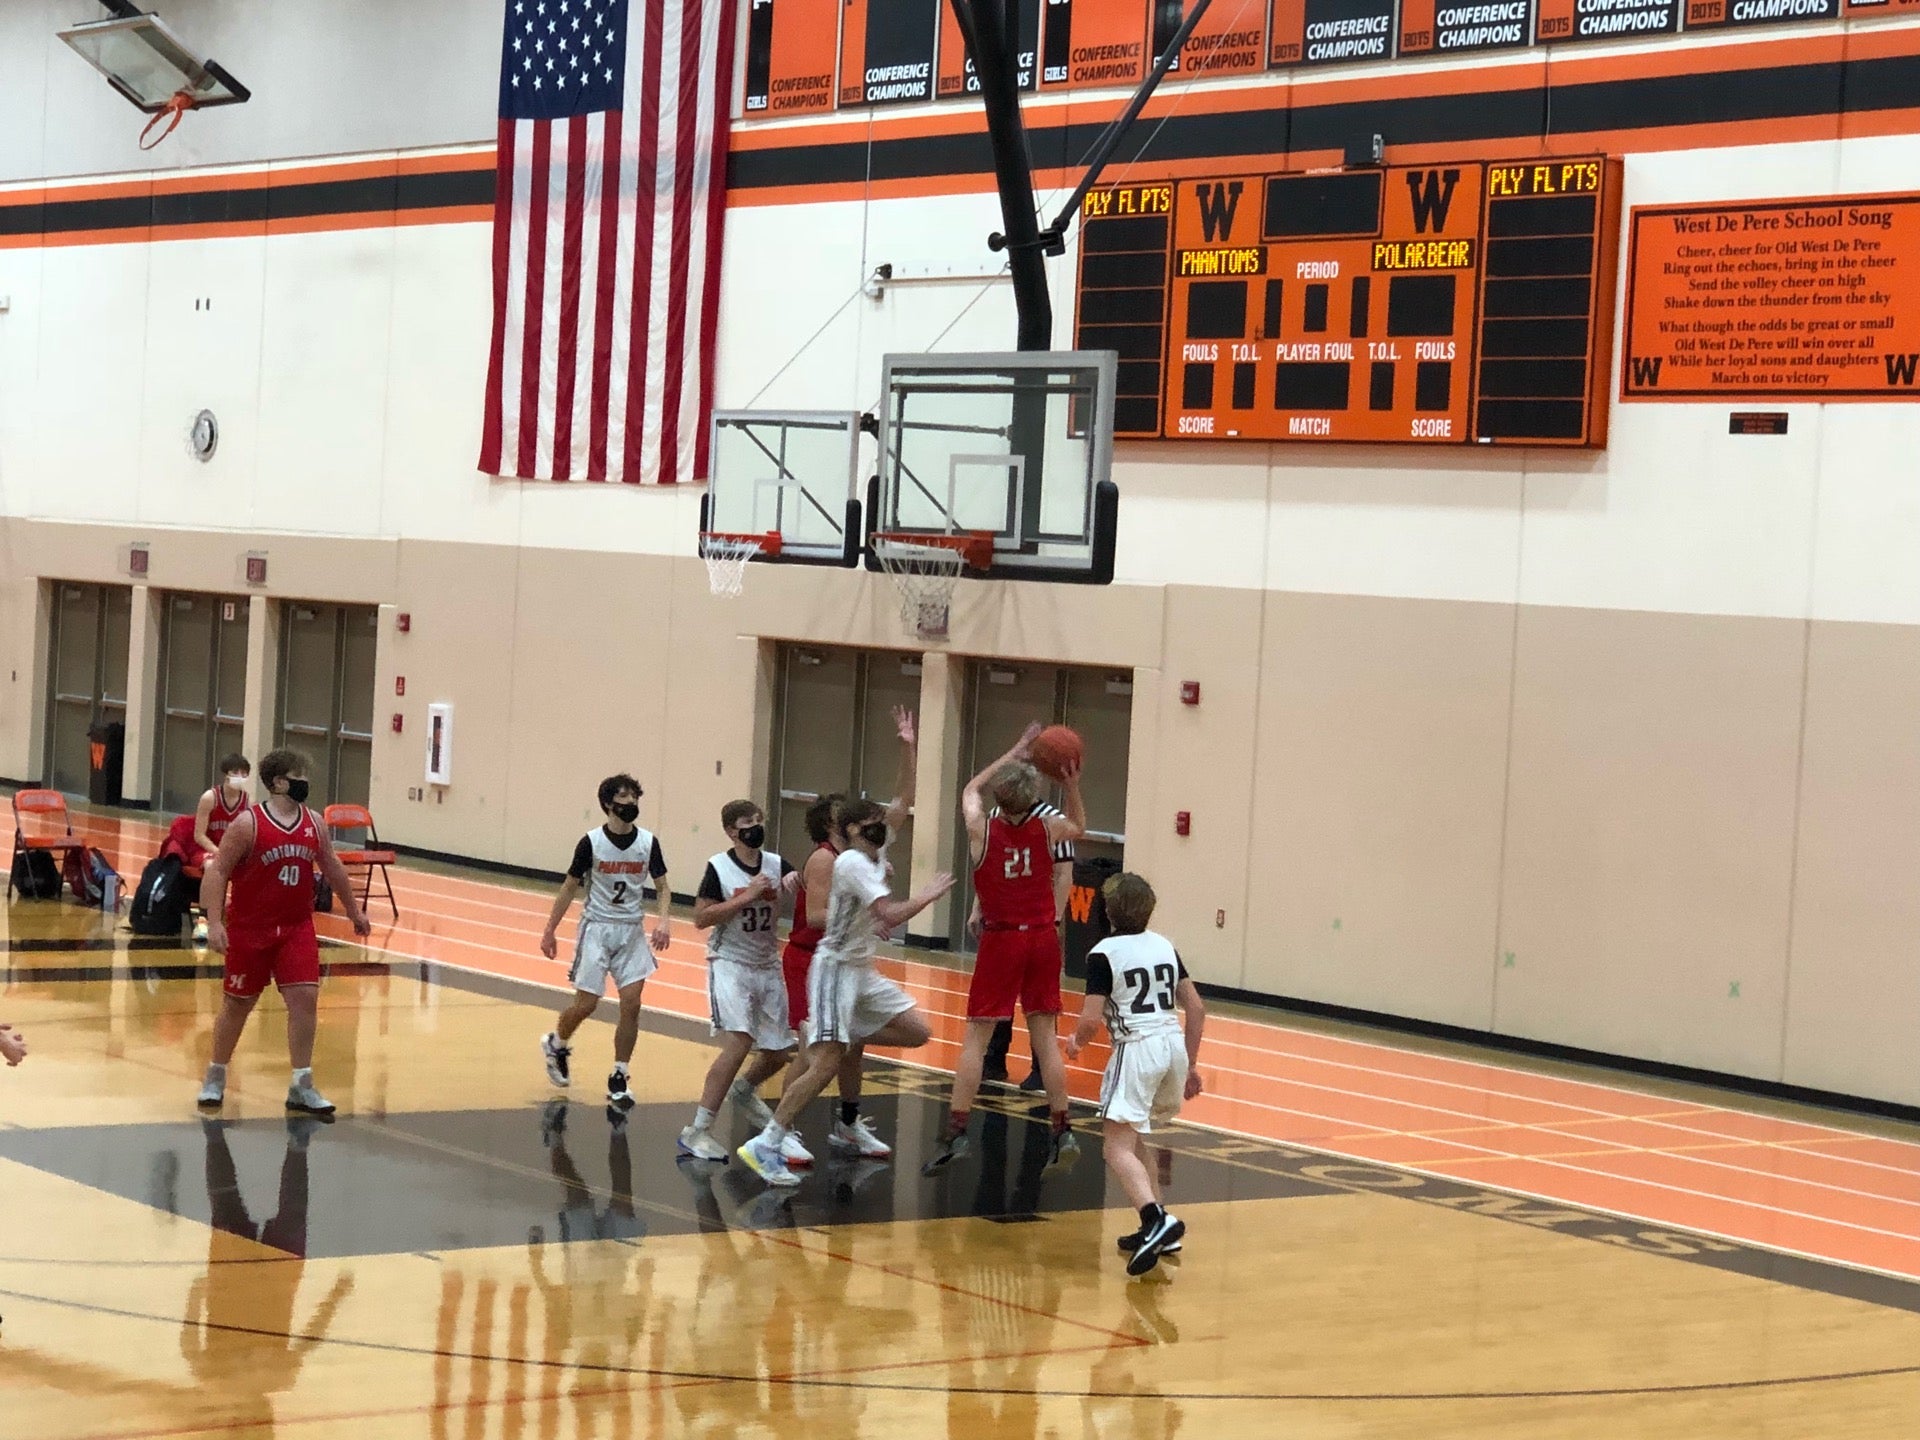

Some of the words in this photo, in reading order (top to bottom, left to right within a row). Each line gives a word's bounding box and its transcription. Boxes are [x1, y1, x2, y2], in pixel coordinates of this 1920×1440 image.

[1437, 2, 1525, 27] CONFERENCE
[1578, 0, 1672, 12] CONFE
[1691, 2, 1721, 20] BOYS
[1733, 0, 1828, 20] CHAMPIONS
[1307, 16, 1389, 39] CONFERENCE
[1542, 17, 1569, 34] BOYS
[1580, 10, 1669, 34] CHAMPIONS
[1184, 31, 1260, 52] CONFERENCE
[1439, 24, 1522, 48] CHAMPIONS
[1072, 42, 1141, 63] CONFERENCE
[1308, 37, 1384, 60] CHAMPIONS
[1074, 62, 1138, 82] CHAMPIONS
[1186, 52, 1256, 72] CHAMPIONS
[772, 74, 831, 92] CONFERENCE
[866, 63, 930, 83] CONFERENCE
[1044, 66, 1067, 82] GIRLS
[773, 92, 828, 110] CHAMPIONS
[867, 82, 926, 100] CHAMPIONS
[1490, 168, 1524, 195] PLY
[1533, 166, 1555, 193] FL
[1561, 164, 1598, 191] PTS
[1084, 190, 1112, 216] PLY
[1118, 190, 1136, 214] FL
[1140, 188, 1170, 212] PTS
[1406, 169, 1460, 234] W
[1196, 182, 1243, 242] W
[1673, 217, 1710, 234] West
[1716, 215, 1738, 232] De
[1743, 214, 1780, 230] Pere
[1784, 210, 1843, 229] School
[1848, 208, 1893, 230] Song
[1677, 246, 1716, 258] Cheer,
[1719, 244, 1752, 256] cheer
[1755, 243, 1772, 255] for
[1776, 241, 1798, 254] Old
[1802, 240, 1829, 252] West
[1834, 240, 1850, 252] De
[1853, 239, 1881, 251] Pere
[1181, 250, 1259, 275] PHANTOMS
[1296, 261, 1338, 279] PERIOD
[1664, 262, 1691, 277] Ring
[1694, 263, 1713, 273] out
[1716, 260, 1734, 272] the
[1738, 260, 1782, 273] echoes,
[1785, 258, 1818, 272] bring
[1822, 258, 1834, 268] in
[1838, 256, 1858, 268] the
[1861, 255, 1896, 268] cheer
[1688, 278, 1718, 290] Send
[1721, 278, 1740, 290] the
[1743, 277, 1778, 292] volley
[1781, 276, 1815, 288] cheer
[1818, 278, 1834, 286] on
[1838, 274, 1866, 290] high
[1664, 296, 1700, 309] Shake
[1702, 296, 1734, 308] down
[1738, 294, 1757, 306] the
[1760, 294, 1809, 306] thunder
[1812, 292, 1842, 304] from
[1846, 292, 1866, 304] the
[1870, 291, 1891, 307] sky
[1660, 321, 1690, 333] What
[1692, 320, 1734, 335] though
[1737, 320, 1756, 331] the
[1759, 319, 1788, 330] odds
[1790, 318, 1804, 330] be
[1808, 320, 1840, 333] great
[1843, 320, 1856, 329] or
[1860, 316, 1894, 329] small
[1182, 344, 1218, 361] FOULS
[1231, 344, 1262, 361] T.O.L.
[1276, 344, 1320, 360] PLAYER
[1324, 343, 1354, 360] FOUL
[1368, 342, 1401, 360] T.O.L.
[1415, 342, 1456, 360] FOULS
[1675, 338, 1695, 351] Old
[1699, 338, 1726, 350] West
[1729, 338, 1744, 350] De
[1747, 338, 1774, 349] Pere
[1777, 337, 1798, 349] will
[1802, 337, 1824, 348] win
[1828, 340, 1855, 348] over
[1858, 336, 1874, 348] all
[1632, 356, 1662, 386] W
[1668, 355, 1702, 367] While
[1706, 354, 1725, 366] her
[1728, 354, 1757, 369] loyal
[1760, 356, 1786, 366] sons
[1790, 354, 1813, 365] and
[1817, 353, 1879, 368] daughters
[1884, 354, 1920, 385] W
[1712, 372, 1750, 383] March
[1752, 374, 1768, 383] on
[1771, 373, 1783, 383] to
[1786, 371, 1829, 387] victory
[1178, 416, 1214, 434] SCORE
[1289, 418, 1330, 435] MATCH
[1411, 419, 1452, 437] SCORE
[1004, 848, 1032, 878] 21
[278, 865, 299, 886] 40
[612, 881, 626, 904] 2
[1070, 886, 1095, 924] W
[742, 906, 771, 932] 32
[1124, 963, 1175, 1014] 23
